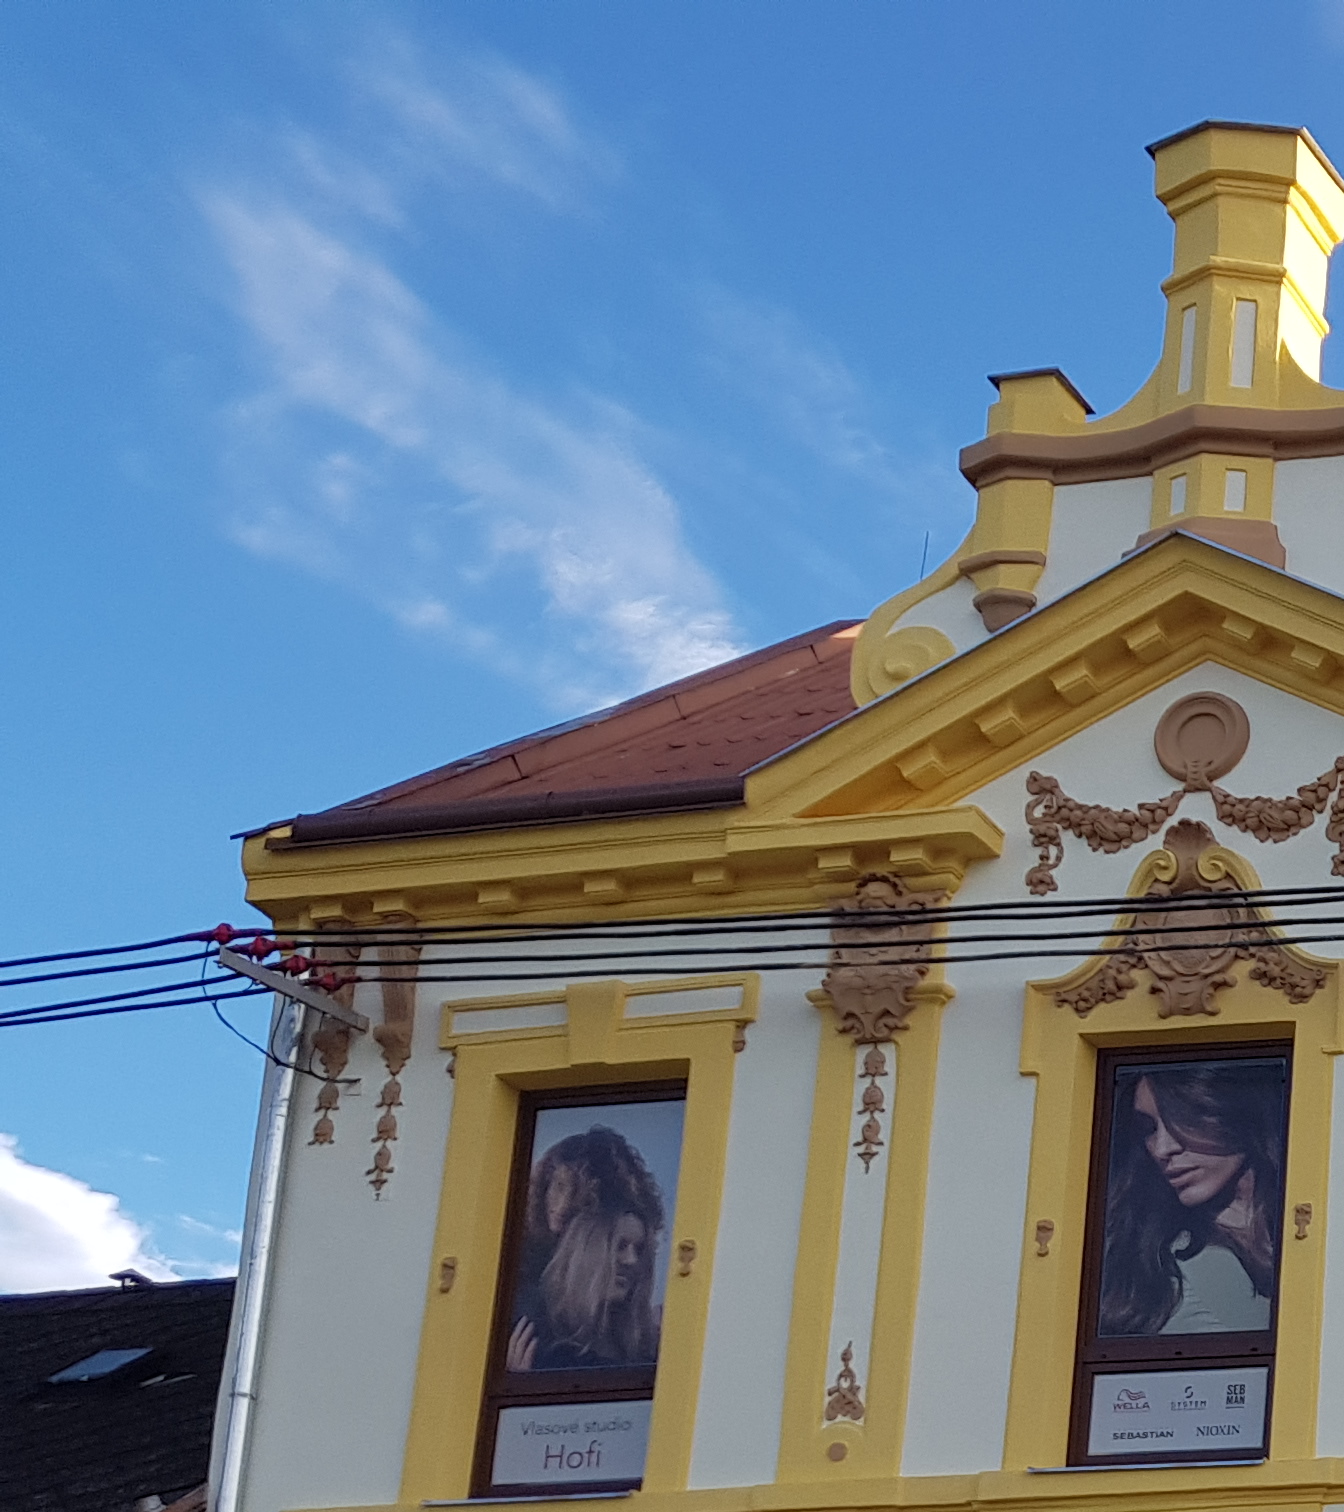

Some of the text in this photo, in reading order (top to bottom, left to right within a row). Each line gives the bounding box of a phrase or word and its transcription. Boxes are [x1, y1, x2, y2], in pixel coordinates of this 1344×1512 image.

[1227, 1384, 1246, 1395] SEB
[1226, 1395, 1246, 1405] MAN
[1113, 1402, 1150, 1411] WELLA
[584, 1416, 632, 1433] studio
[1112, 1430, 1174, 1440] SEBASTIAN
[1196, 1425, 1241, 1437] NIOXIN
[543, 1439, 602, 1469] Hofi
